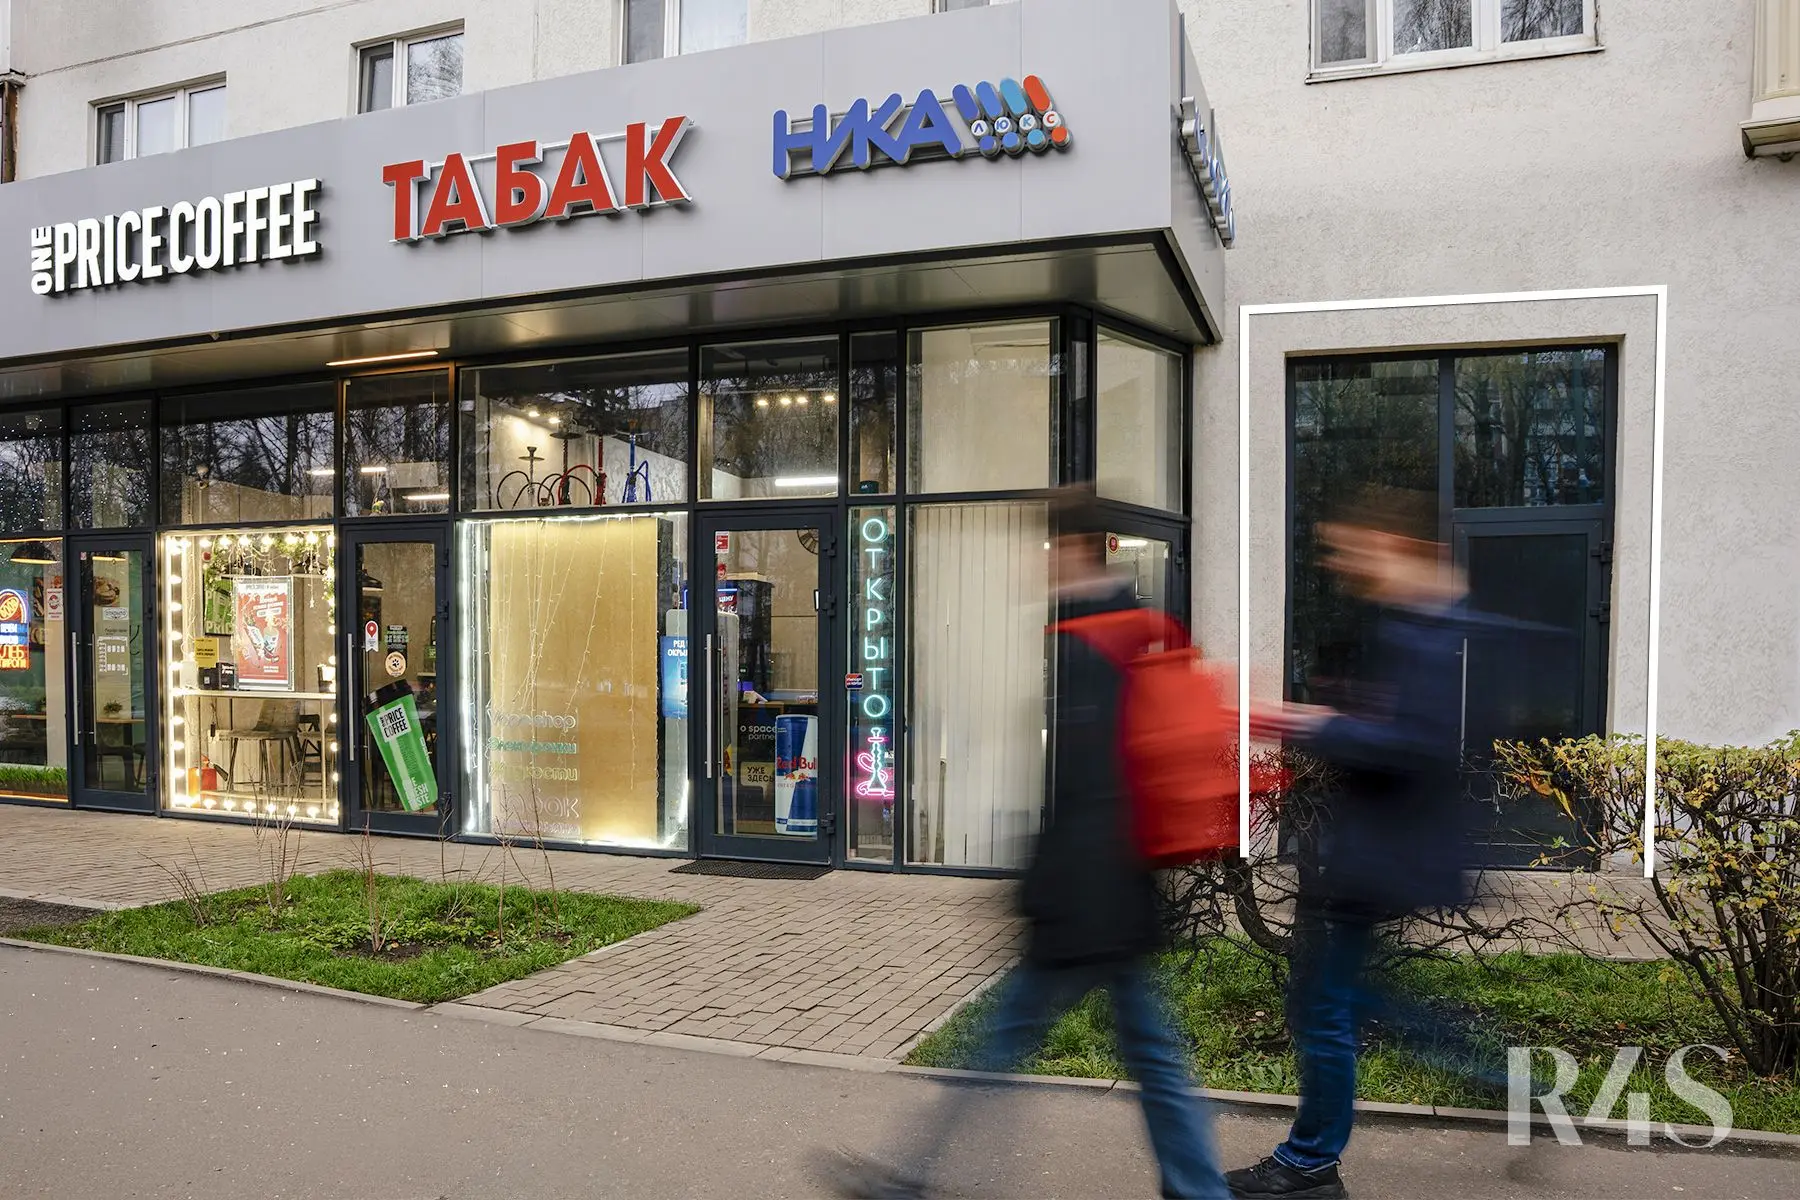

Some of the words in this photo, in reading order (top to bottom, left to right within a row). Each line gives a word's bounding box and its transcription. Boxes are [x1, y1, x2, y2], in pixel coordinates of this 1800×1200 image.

[382, 114, 693, 243] ТАБАК
[55, 205, 168, 293] PRICE
[169, 177, 322, 274] COFFEE
[31, 225, 54, 295] ONE
[861, 518, 887, 718] ОТКРЫТО
[0, 643, 25, 660] ЛЕБ
[384, 707, 405, 726] PRICE
[383, 718, 409, 738] COFFEE
[747, 766, 765, 774] УЖЕ
[776, 755, 797, 770] Red
